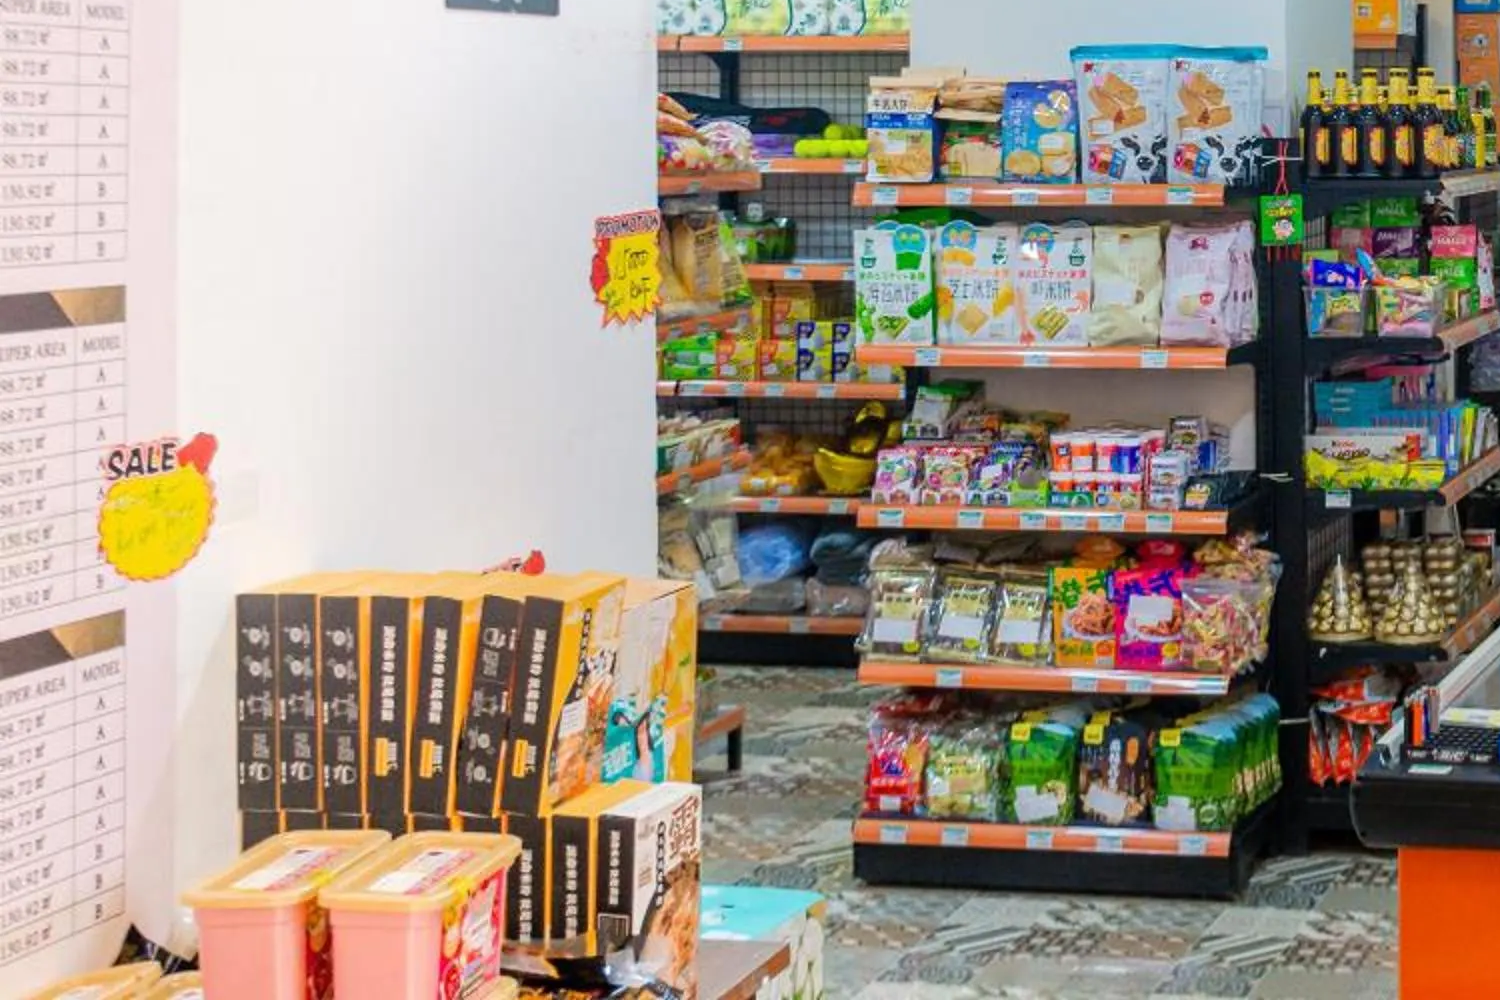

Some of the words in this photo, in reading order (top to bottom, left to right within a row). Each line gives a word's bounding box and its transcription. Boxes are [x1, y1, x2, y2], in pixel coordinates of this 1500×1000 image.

[39, 0, 70, 16] AREA
[86, 4, 124, 20] MODEL
[37, 341, 67, 358] AREA
[82, 335, 121, 351] MODEL
[107, 442, 177, 481] SALE
[36, 677, 66, 696] AREA
[83, 660, 121, 683] MODEL
